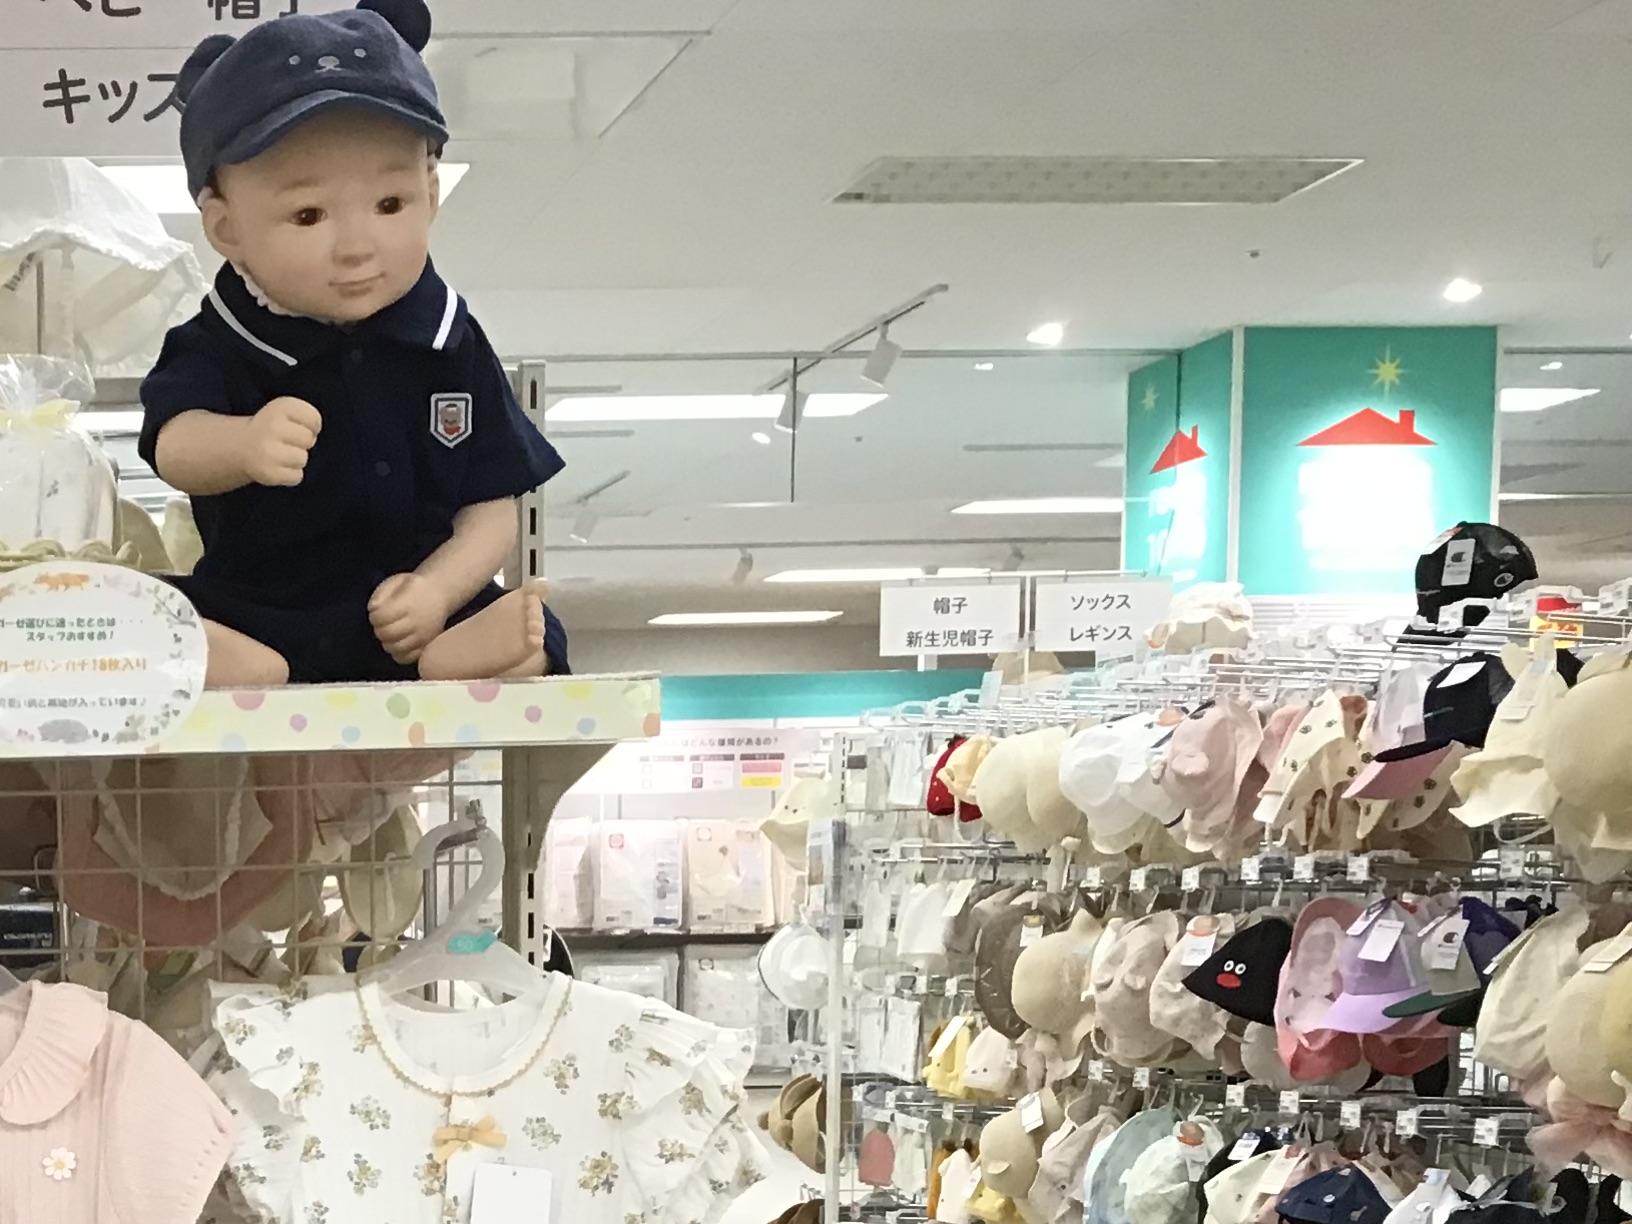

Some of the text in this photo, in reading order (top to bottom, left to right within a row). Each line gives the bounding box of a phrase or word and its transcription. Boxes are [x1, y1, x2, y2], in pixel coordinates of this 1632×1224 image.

[933, 596, 968, 614] 帽子
[1071, 594, 1132, 611] ソックス
[906, 629, 994, 648] 新生児帽子
[1070, 625, 1133, 642] レギンス
